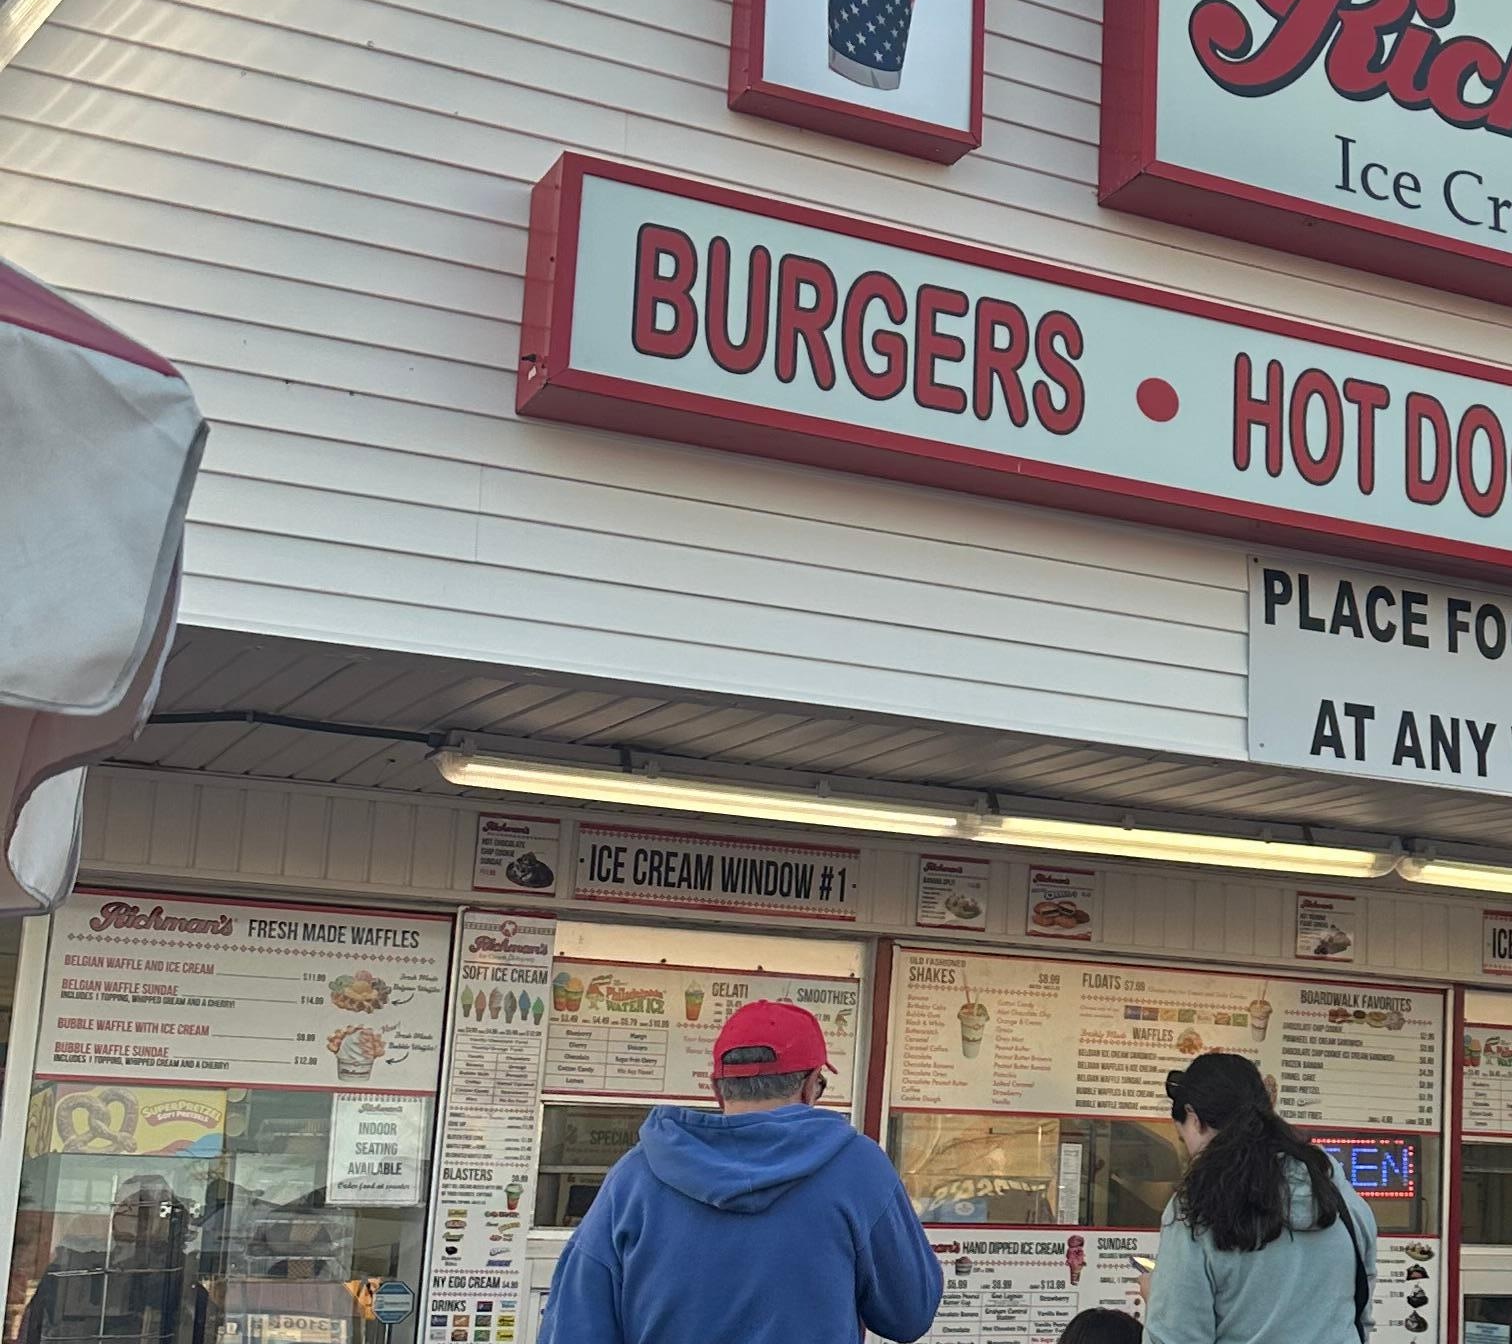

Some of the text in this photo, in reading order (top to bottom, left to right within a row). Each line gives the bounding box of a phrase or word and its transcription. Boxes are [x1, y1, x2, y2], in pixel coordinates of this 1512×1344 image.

[1333, 134, 1422, 209] Ice
[631, 221, 1086, 436] BURGERS
[1231, 350, 1391, 496] HOT
[1262, 567, 1430, 650] PLACE
[1309, 698, 1375, 761] AT
[1391, 708, 1498, 778] ANY
[589, 844, 846, 902] ICE CREAM WINDOW #1
[89, 901, 420, 949] Richman's FRESH MADE WAFFLES
[64, 954, 214, 975] BELGIAN WAFFLE AND ICE CREAM
[462, 964, 548, 984] SOFT ICE CREAM
[909, 966, 955, 984] SHAKES
[1082, 972, 1121, 990] FLOATS
[61, 991, 93, 1000] INCLUDES
[62, 979, 178, 996] BELGIAN WAFFLE SUNDAE
[712, 982, 748, 999] GELATI
[797, 988, 856, 1005] SMOOTHIES
[1301, 989, 1412, 1013] BOARDWALK FAVORITES
[646, 999, 665, 1014] ICE
[57, 1017, 209, 1036] BUBBLE WAFFLE WITH ICE CREAM
[1132, 1026, 1174, 1042] WAFFLES
[54, 1042, 169, 1057] BUBBLE WAFFLE SUNDAE
[53, 1054, 86, 1063] INCLUDES
[359, 1122, 397, 1136] INDOOR
[355, 1142, 398, 1155] SEATING
[348, 1162, 402, 1175] AVAILABLE
[443, 1168, 493, 1181] BLASTERS
[1325, 1146, 1408, 1186] EN
[963, 1241, 1065, 1255] HAND DIPPED ICE CREAM
[1097, 1238, 1137, 1250] SUNDAES
[433, 1276, 500, 1288] NY EGG CREAM
[432, 1300, 466, 1311] DRINKS
